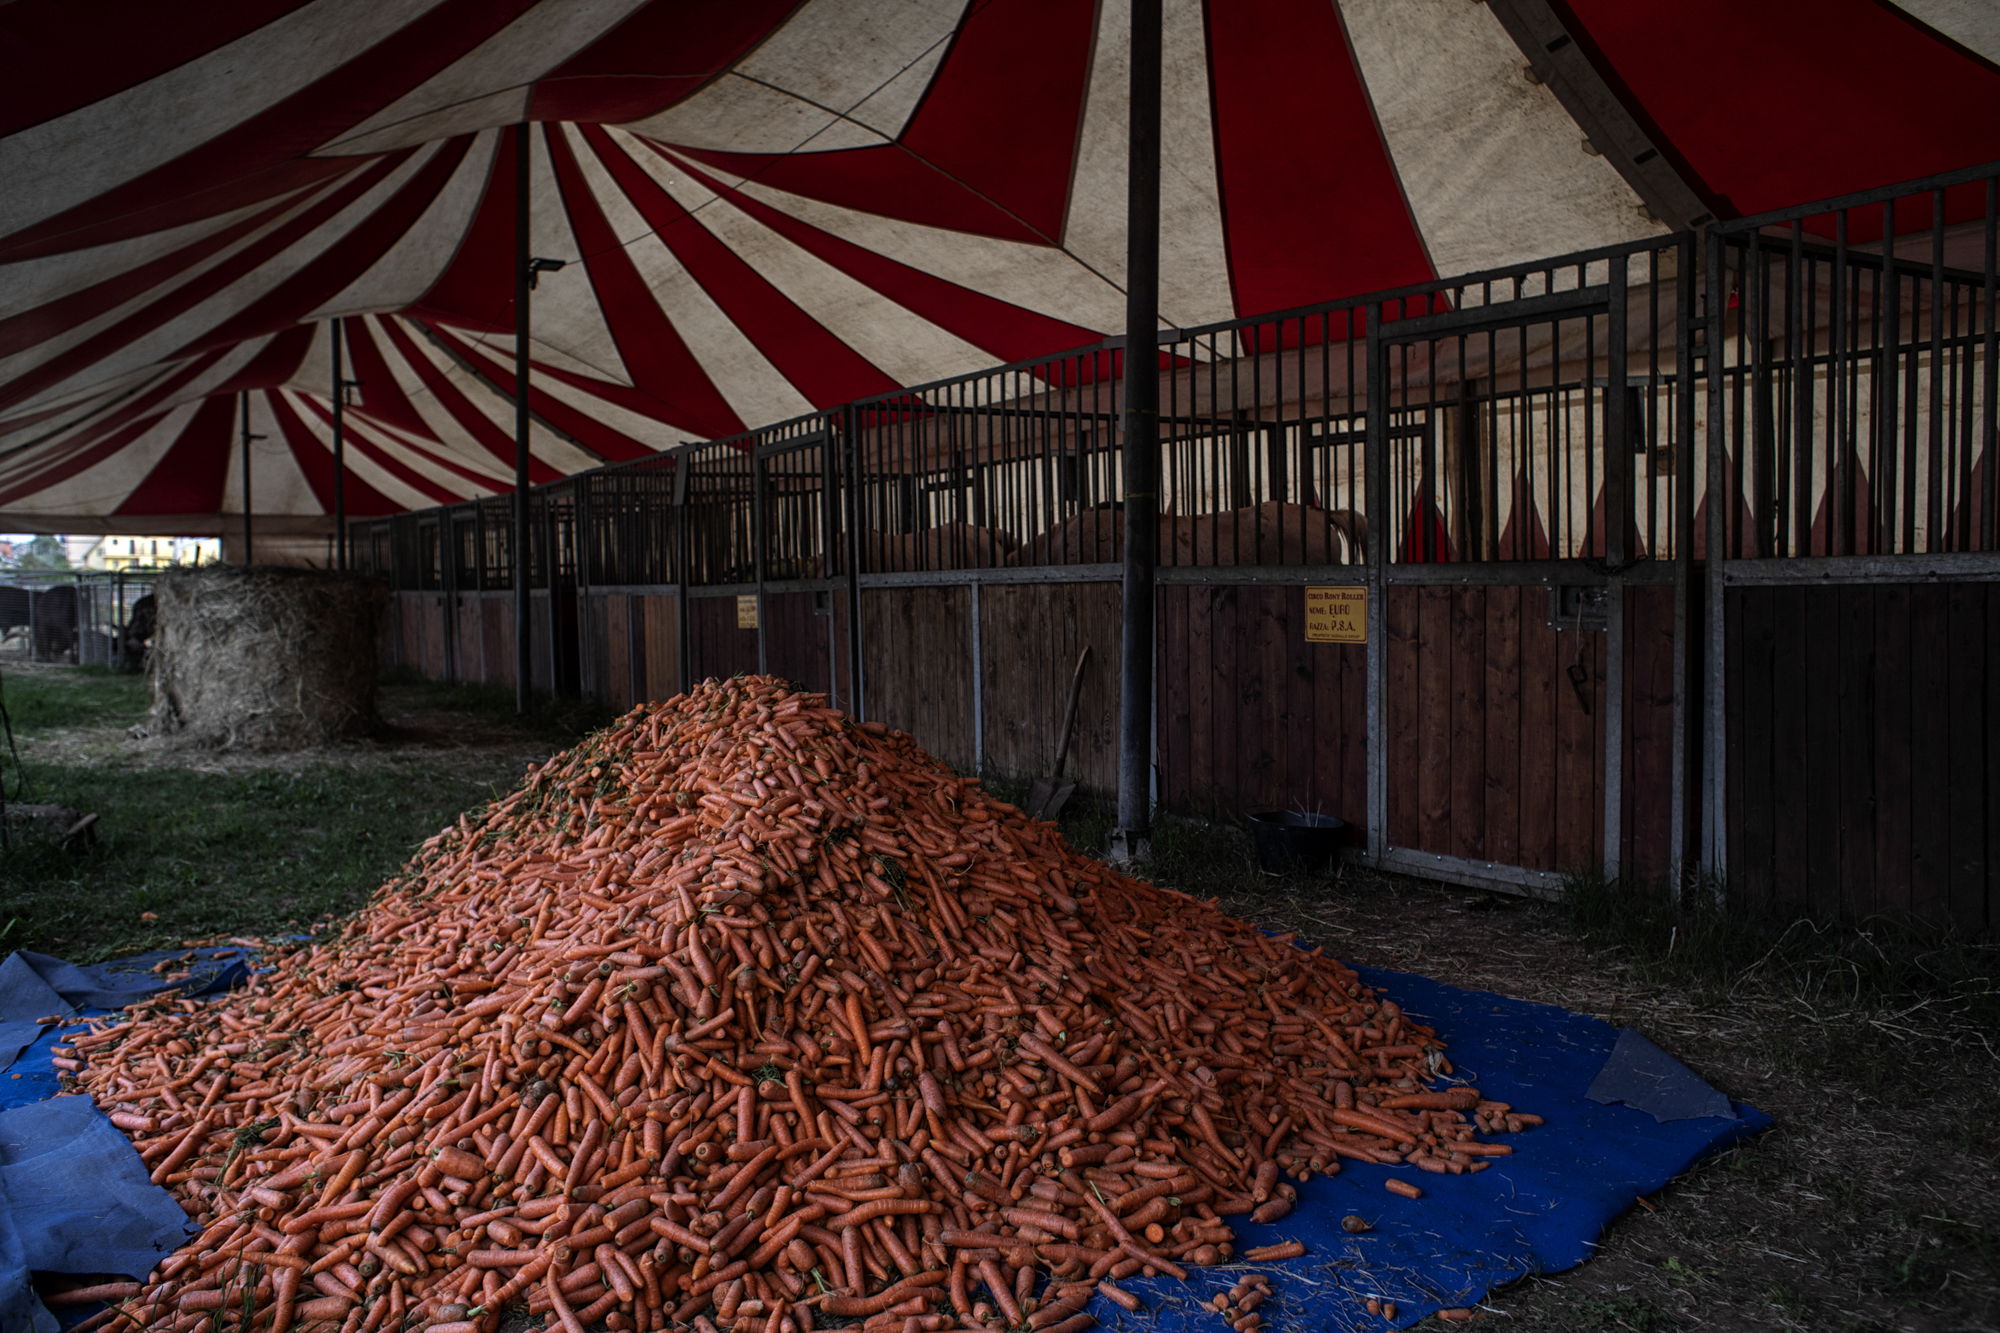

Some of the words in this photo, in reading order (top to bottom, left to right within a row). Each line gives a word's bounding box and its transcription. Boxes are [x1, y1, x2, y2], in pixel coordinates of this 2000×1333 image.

[1324, 592, 1340, 600] RONY
[1341, 592, 1363, 600] ROLLER
[1309, 607, 1327, 615] NOME:
[1329, 604, 1350, 615] EURO
[1331, 620, 1356, 631] P.S.A.
